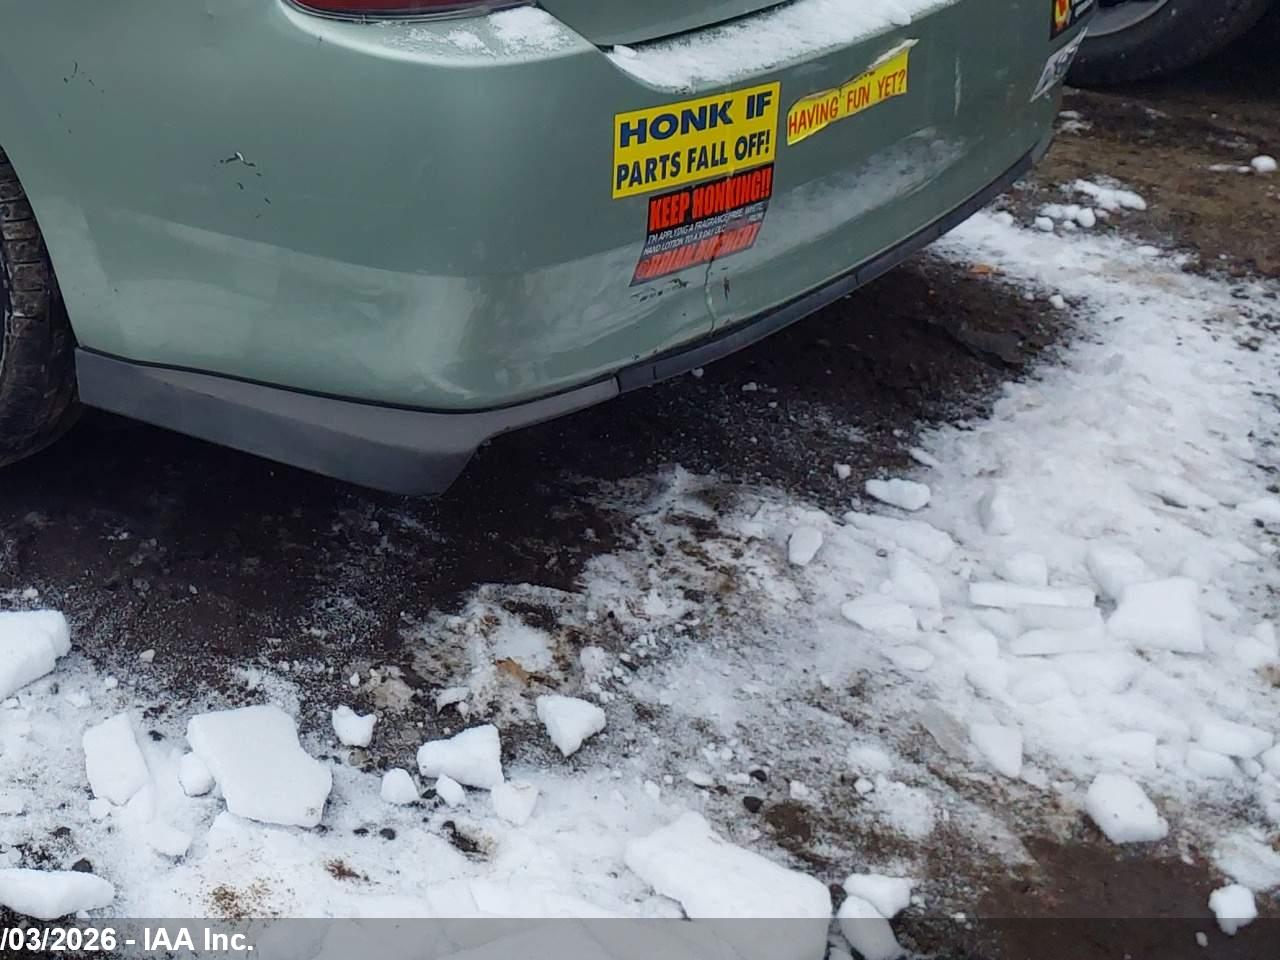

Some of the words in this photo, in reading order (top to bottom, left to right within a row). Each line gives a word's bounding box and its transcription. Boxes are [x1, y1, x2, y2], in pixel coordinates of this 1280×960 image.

[620, 100, 734, 148] HONK
[746, 91, 773, 120] IF
[788, 96, 839, 137] HAVING
[846, 82, 871, 113] FUN
[877, 69, 907, 99] YET?
[616, 151, 681, 190] PARTS
[687, 141, 729, 174] FALL
[734, 129, 771, 161] OFF!
[649, 191, 691, 231] KEEP
[691, 167, 773, 220] HONKING!!
